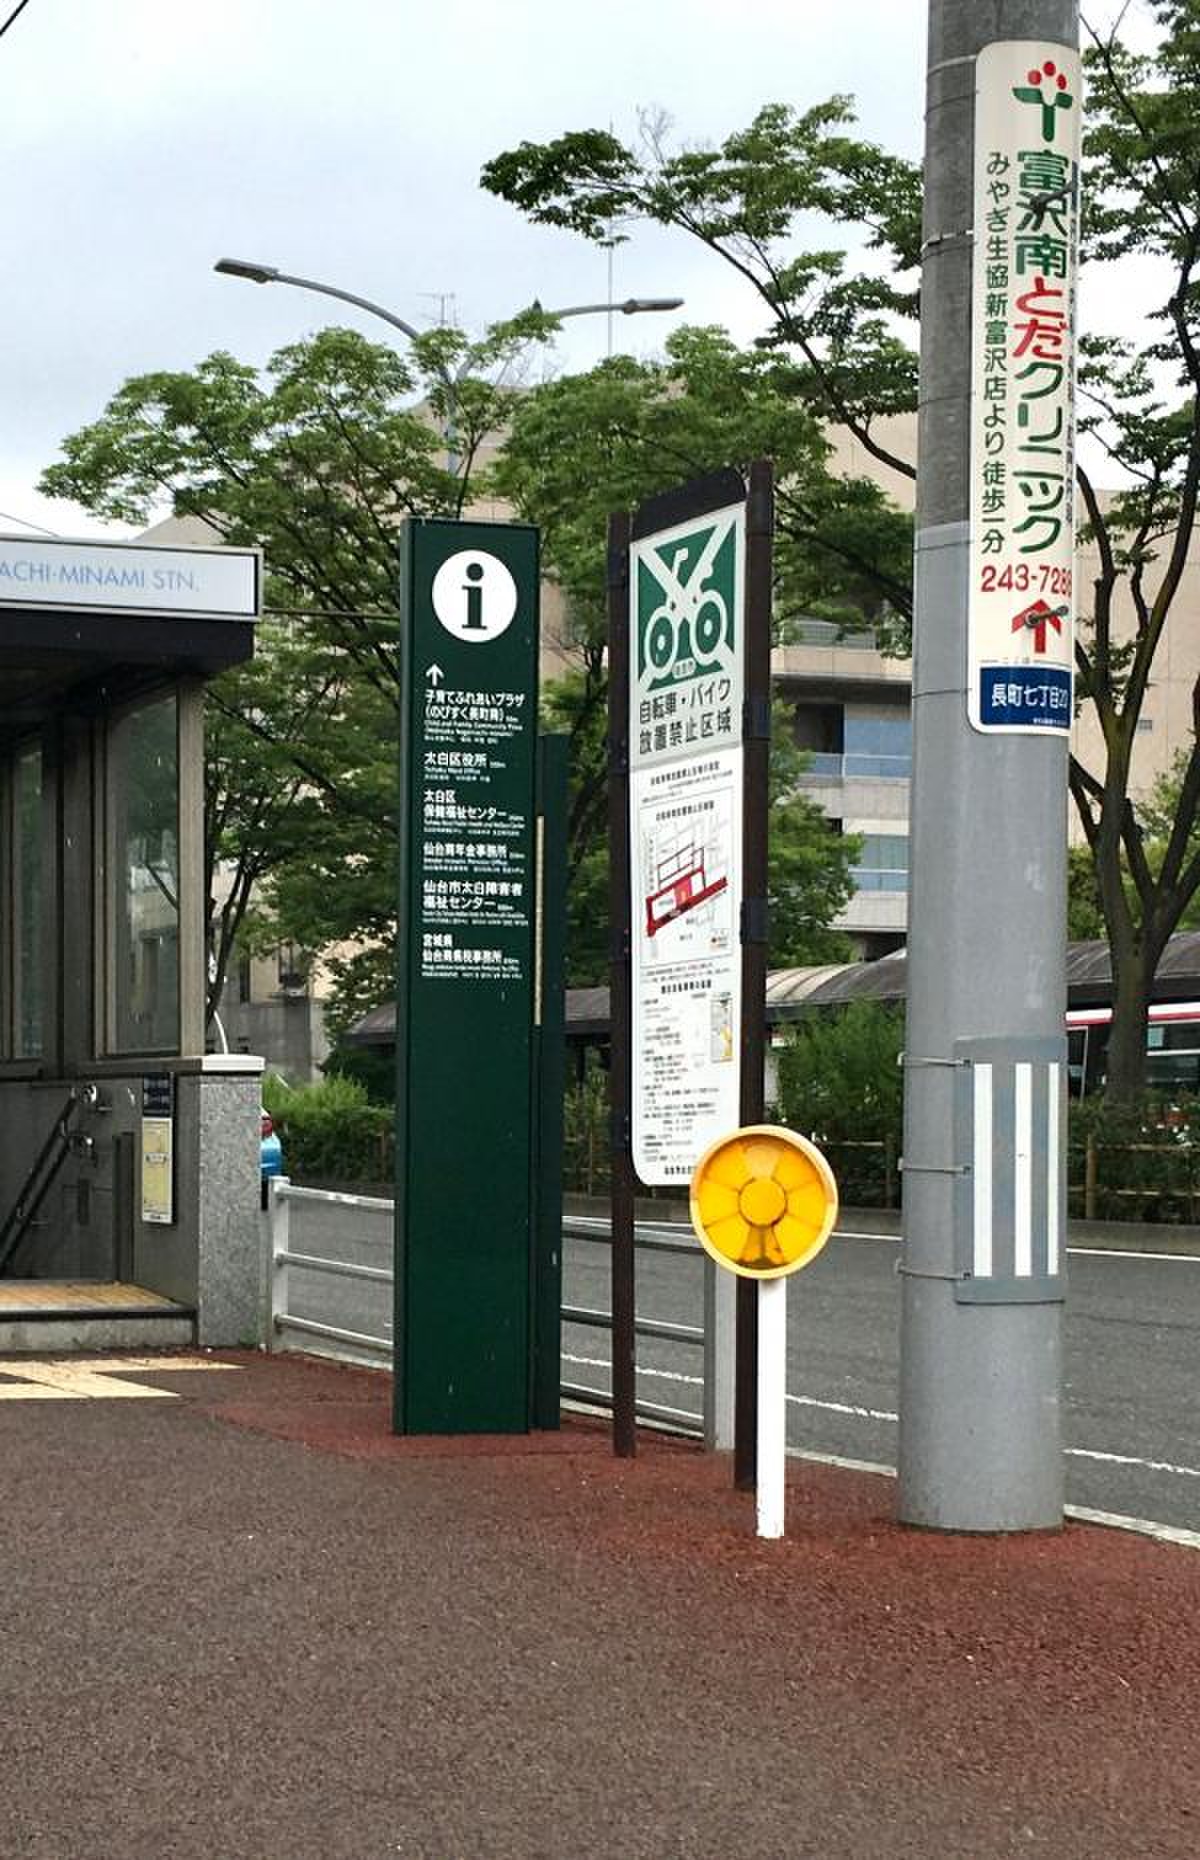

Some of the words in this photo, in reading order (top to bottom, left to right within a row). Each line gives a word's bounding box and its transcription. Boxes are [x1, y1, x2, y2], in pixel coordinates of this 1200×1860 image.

[981, 151, 1011, 555] みやぎ生協新富沢店より徒歩一分
[1012, 149, 1069, 553] 富沢南とだクリニック
[152, 570, 200, 592] STN.
[425, 689, 525, 707] 子育てふれあいプラザ
[639, 678, 731, 725] 自転車・バイク
[639, 706, 731, 756] 放置禁止区域
[424, 752, 487, 768] 太白区役所
[424, 789, 456, 804] 太白区
